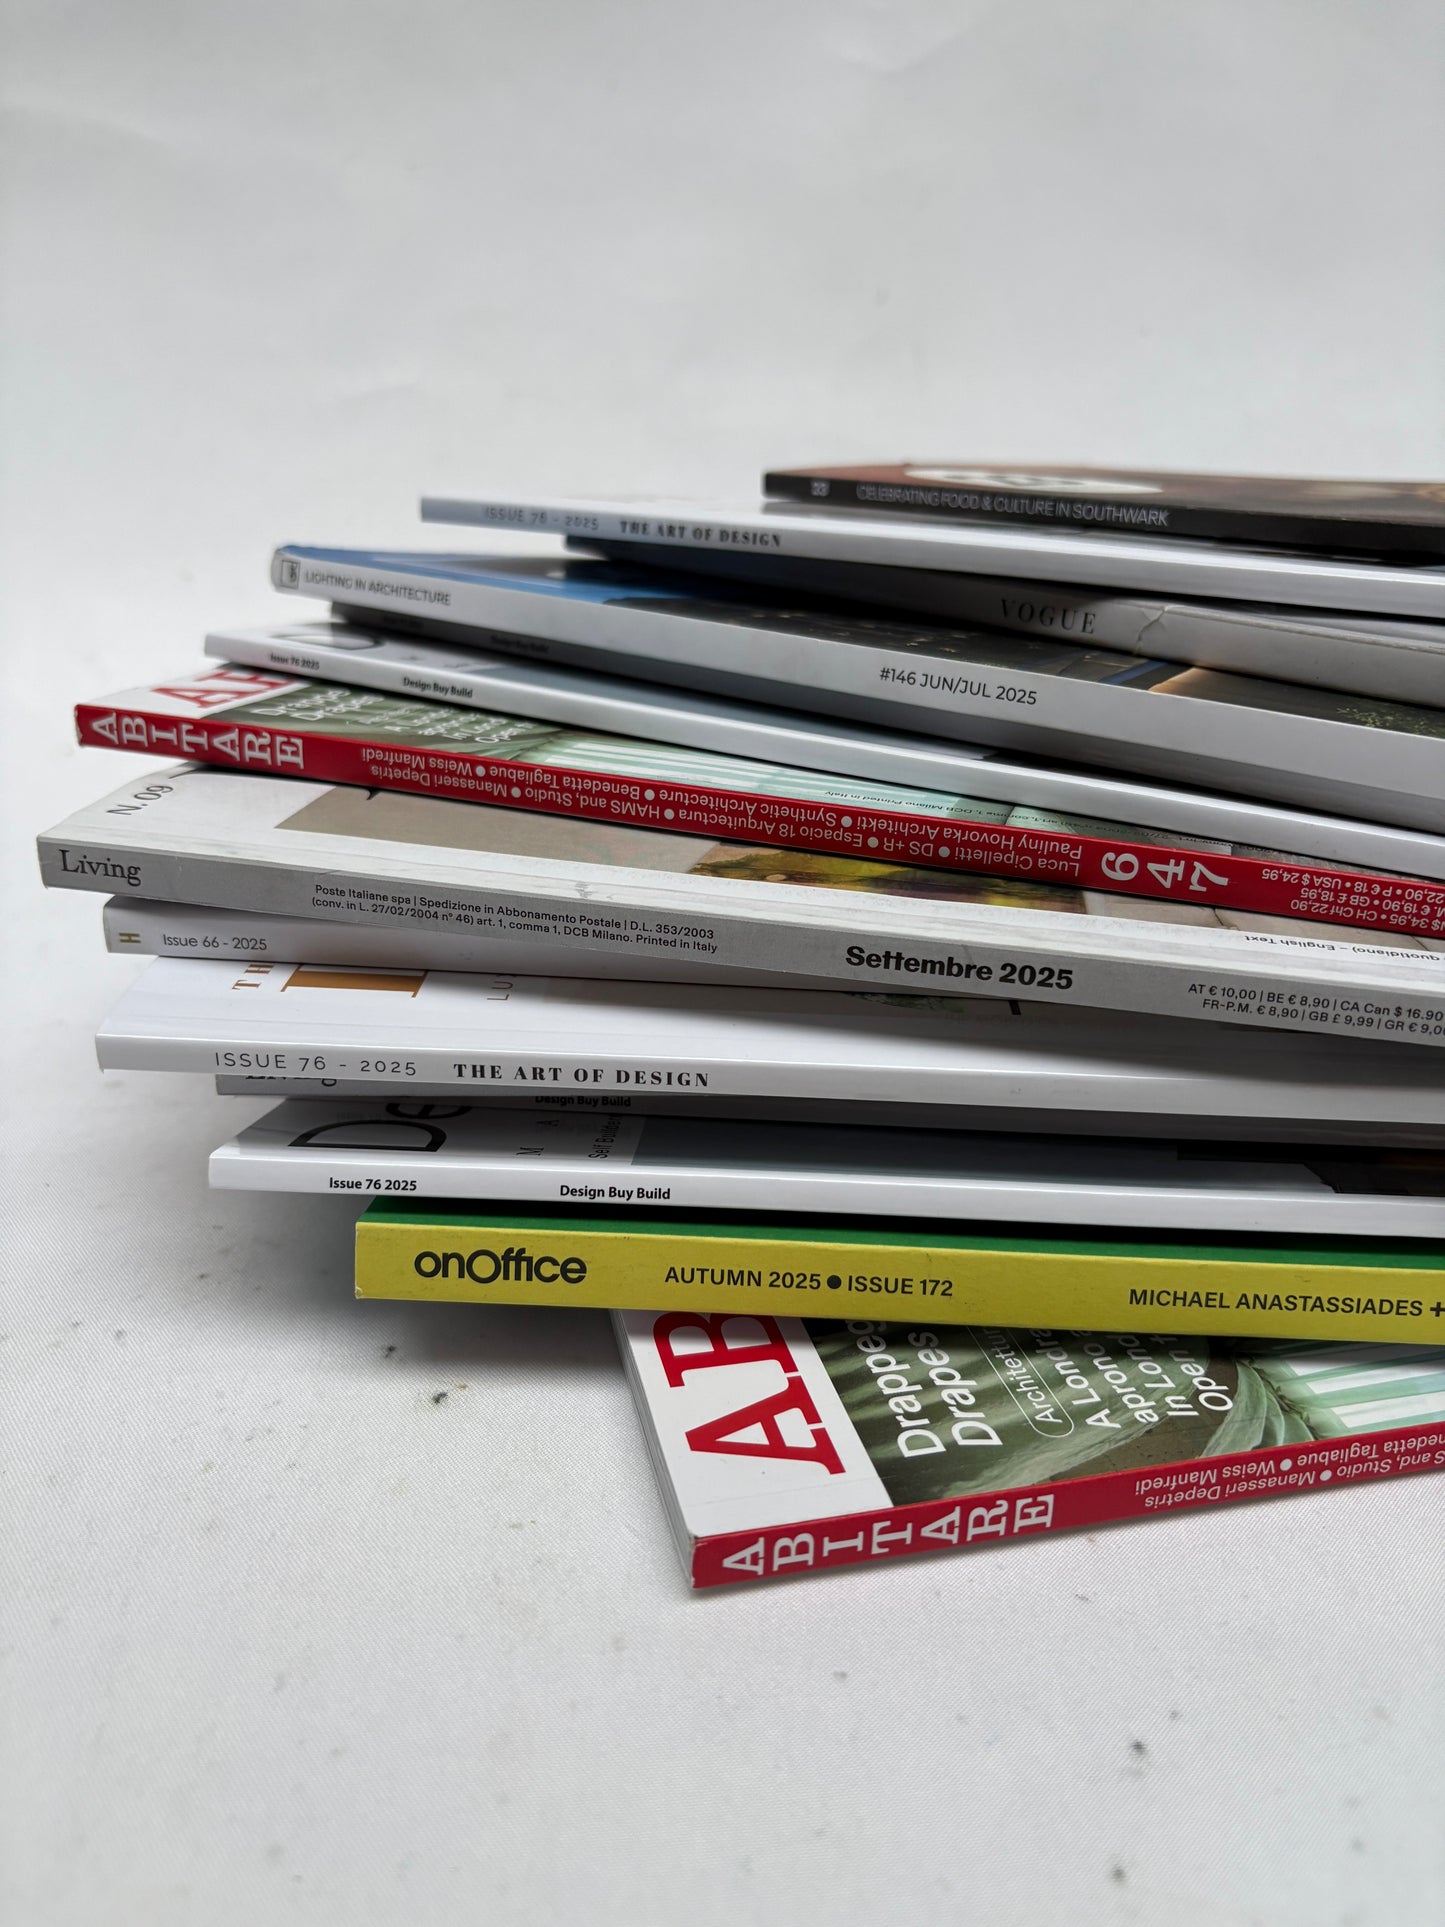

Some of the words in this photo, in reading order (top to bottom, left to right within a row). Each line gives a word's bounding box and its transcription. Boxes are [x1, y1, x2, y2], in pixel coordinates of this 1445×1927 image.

[856, 481, 939, 507] CELEBRATING
[941, 489, 979, 510] FOOD
[994, 494, 1053, 517] CULTURE
[1056, 501, 1067, 517] IN
[1071, 504, 1169, 527] SOUTHWARK
[485, 506, 524, 522] ISSUE
[565, 516, 599, 531] 2025
[620, 520, 649, 535] THE
[656, 524, 686, 539] ART
[692, 528, 712, 541] OF
[720, 531, 781, 548] DESIGN
[304, 573, 353, 590] LIGHTING
[355, 580, 366, 592] IN
[368, 581, 451, 606] ARCHITECTURE
[1000, 598, 1096, 635] VOGUE
[270, 653, 289, 665] Issue
[300, 658, 320, 670] 2025
[403, 676, 432, 692] Design
[433, 682, 449, 697] Buy
[451, 685, 473, 698] Build
[879, 667, 916, 686] #146
[920, 673, 991, 699] JUN/JUL
[995, 686, 1037, 705] 2025
[91, 712, 305, 770] ABITARE
[362, 747, 425, 769] Manfredi
[429, 756, 472, 776] Weiss
[370, 765, 431, 786] Depetris
[434, 775, 507, 797] Manasseri
[489, 765, 560, 790] Tagliabue
[525, 788, 573, 807] Studio
[562, 777, 640, 799] Benedetta
[577, 793, 607, 808] and,
[610, 801, 659, 819] HAMS
[659, 788, 757, 815] Architecture
[679, 809, 775, 835] Arquitectura
[760, 802, 837, 827] Synthetic
[778, 822, 796, 838] 18
[800, 825, 862, 848] Espacio
[857, 815, 939, 840] Architekti
[943, 827, 1013, 850] Hovorka
[909, 840, 933, 857] DS
[954, 846, 1033, 870] Cipelletti
[1017, 836, 1083, 860] Pauliny
[58, 848, 142, 887] Living
[1038, 856, 1080, 877] Luca
[1262, 868, 1300, 884] 24,95
[1313, 876, 1342, 890] USA
[1353, 882, 1368, 893] 18
[1382, 886, 1393, 897] P
[1300, 887, 1335, 902] 18,95
[1349, 894, 1370, 907] GB
[1404, 888, 1445, 904] 22,90
[315, 884, 346, 897] Poste
[349, 888, 389, 902] Italiane
[391, 896, 411, 907] spa
[420, 897, 481, 913] Spedizione
[484, 903, 494, 914] in
[497, 905, 577, 924] Abbonamento
[579, 915, 621, 929] Postale
[630, 921, 652, 932] D.L.
[655, 923, 714, 939] 353/2003
[1290, 899, 1327, 914] 22,90
[1330, 905, 1354, 918] Chf
[1356, 909, 1378, 921] CH
[1382, 899, 1418, 914] 19,90
[312, 897, 344, 909] (conv.
[346, 901, 357, 910] in
[359, 903, 369, 912] L.
[371, 904, 439, 920] 27/02/2004
[455, 913, 474, 926] 46)
[476, 916, 496, 927] art.
[498, 919, 506, 929] 1,
[509, 921, 550, 933] comma
[553, 925, 561, 935] 1,
[563, 926, 589, 937] DCB
[592, 929, 633, 943] Milano.
[636, 934, 677, 948] Printed
[679, 939, 690, 949] in
[693, 940, 718, 954] Italy
[1388, 913, 1430, 929] 34,95
[163, 933, 198, 948] Issue
[202, 936, 220, 948] 66
[232, 937, 268, 951] 2025
[1245, 935, 1278, 945] Text
[1280, 938, 1335, 951] English
[1352, 946, 1440, 961] quotidiano)
[845, 945, 993, 981] Settembre
[999, 962, 1073, 990] 2025
[1188, 983, 1206, 995] AT
[1221, 987, 1256, 1001] 10,00
[1267, 992, 1285, 1004] BE
[1300, 995, 1329, 1009] 8,90
[1340, 1001, 1360, 1012] CA
[1364, 1004, 1390, 1016] Can
[1202, 999, 1253, 1014] FR-P.M.
[1268, 1006, 1298, 1019] 8,90
[1309, 1011, 1328, 1023] GB
[1344, 1015, 1374, 1029] 9,99
[1384, 1019, 1405, 1031] GR
[215, 1052, 287, 1070] ISSUE
[299, 1056, 326, 1072] 76
[360, 1061, 417, 1076] 2025
[453, 1064, 502, 1079] THE
[514, 1066, 563, 1081] ART
[574, 1068, 604, 1083] OF
[615, 1070, 709, 1087] DESIGN
[329, 1177, 362, 1190] Issue
[365, 1179, 381, 1190] 76
[384, 1179, 417, 1191] 2025
[560, 1184, 605, 1199] Design
[608, 1186, 634, 1201] Buy
[636, 1187, 671, 1200] Build
[414, 1246, 588, 1285] onOffice
[664, 1265, 763, 1288] AUTUMN
[768, 1270, 821, 1291] 2025
[847, 1274, 914, 1295] ISSUE
[918, 1277, 954, 1298] 172
[1128, 1288, 1230, 1310] MICHAEL
[1236, 1293, 1423, 1317] ANASTASSIADES
[908, 1331, 1003, 1446] Drapes
[1083, 1342, 1159, 1424] aprono
[1168, 1350, 1234, 1411] Open
[1164, 1395, 1199, 1417] In
[1086, 1408, 1122, 1429] A
[1296, 1442, 1380, 1466] Tagliabue
[1396, 1453, 1431, 1470] and,
[1222, 1459, 1276, 1479] Weiss
[1336, 1459, 1392, 1478] Studio
[1135, 1469, 1218, 1496] Manfredi
[1225, 1470, 1316, 1497] Manasseri
[1145, 1486, 1220, 1508] Depetris
[722, 1493, 1055, 1576] ABITARE
